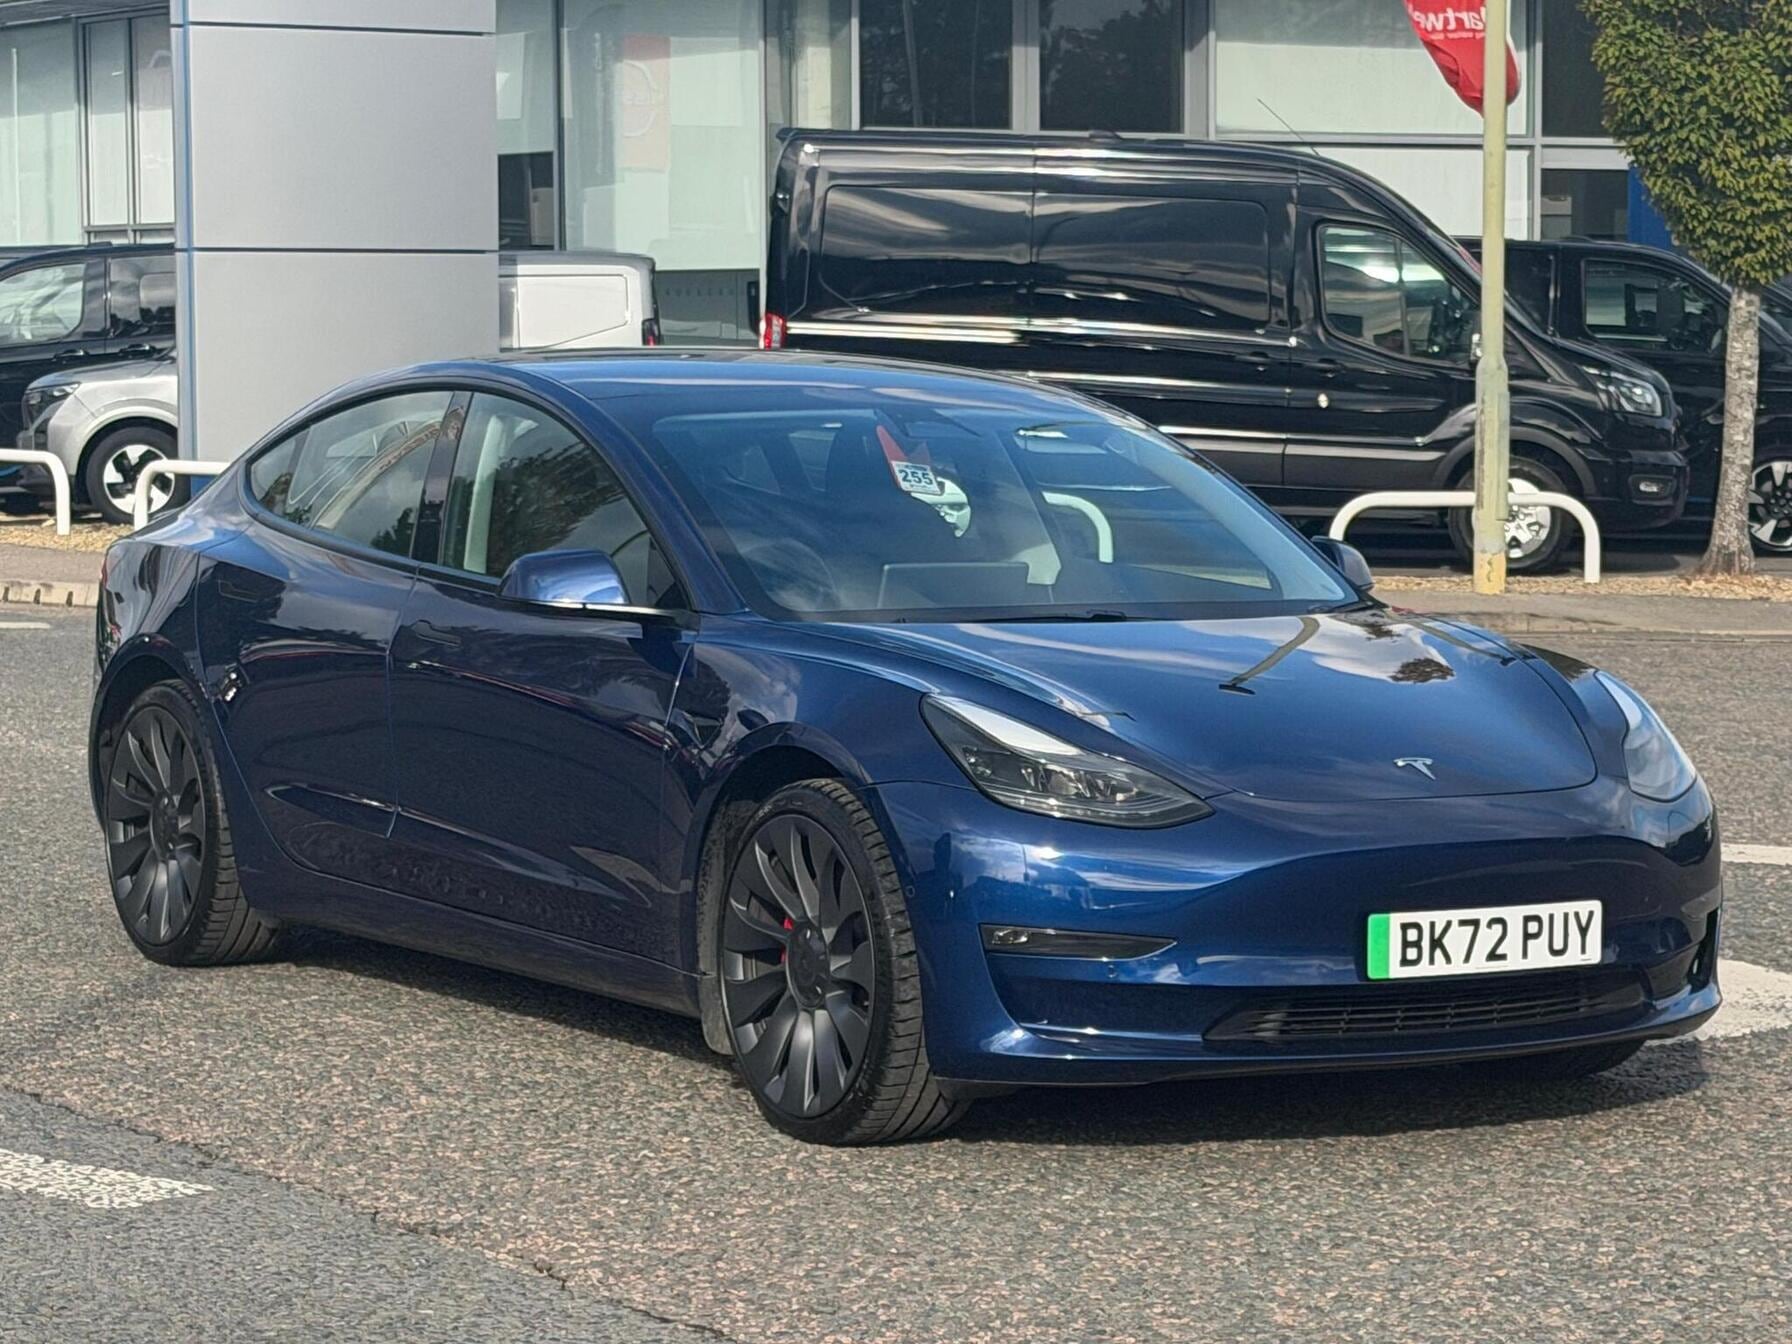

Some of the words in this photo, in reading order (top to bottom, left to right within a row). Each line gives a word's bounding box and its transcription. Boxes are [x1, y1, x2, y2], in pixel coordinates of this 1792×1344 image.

[899, 469, 933, 485] 255
[1399, 917, 1508, 968] BK72
[1521, 910, 1595, 960] PUY
